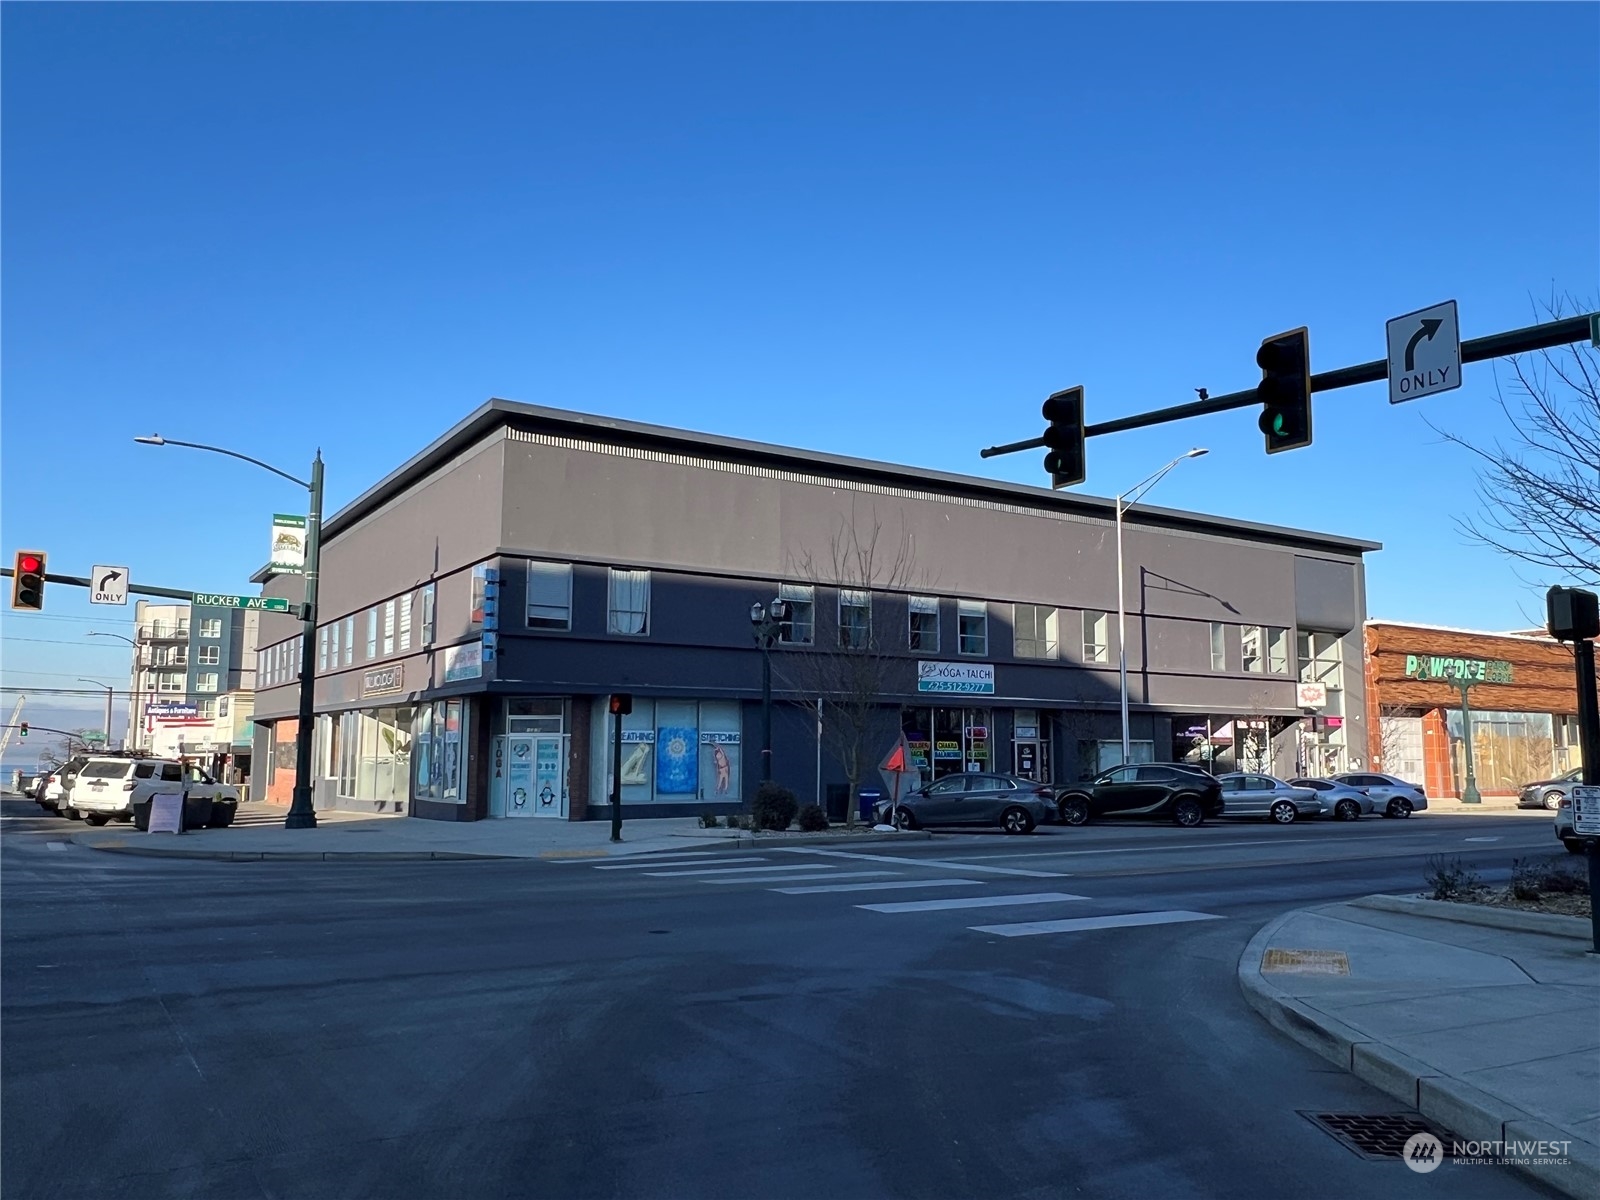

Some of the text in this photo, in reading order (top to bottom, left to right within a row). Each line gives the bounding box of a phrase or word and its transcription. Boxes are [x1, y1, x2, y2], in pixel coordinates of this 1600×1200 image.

[1400, 366, 1449, 393] ONLY
[95, 592, 122, 602] ONLY
[196, 594, 240, 607] RUCKER
[246, 598, 268, 609] AVE
[701, 733, 740, 742] STRETCHING
[495, 739, 503, 778] YOGA
